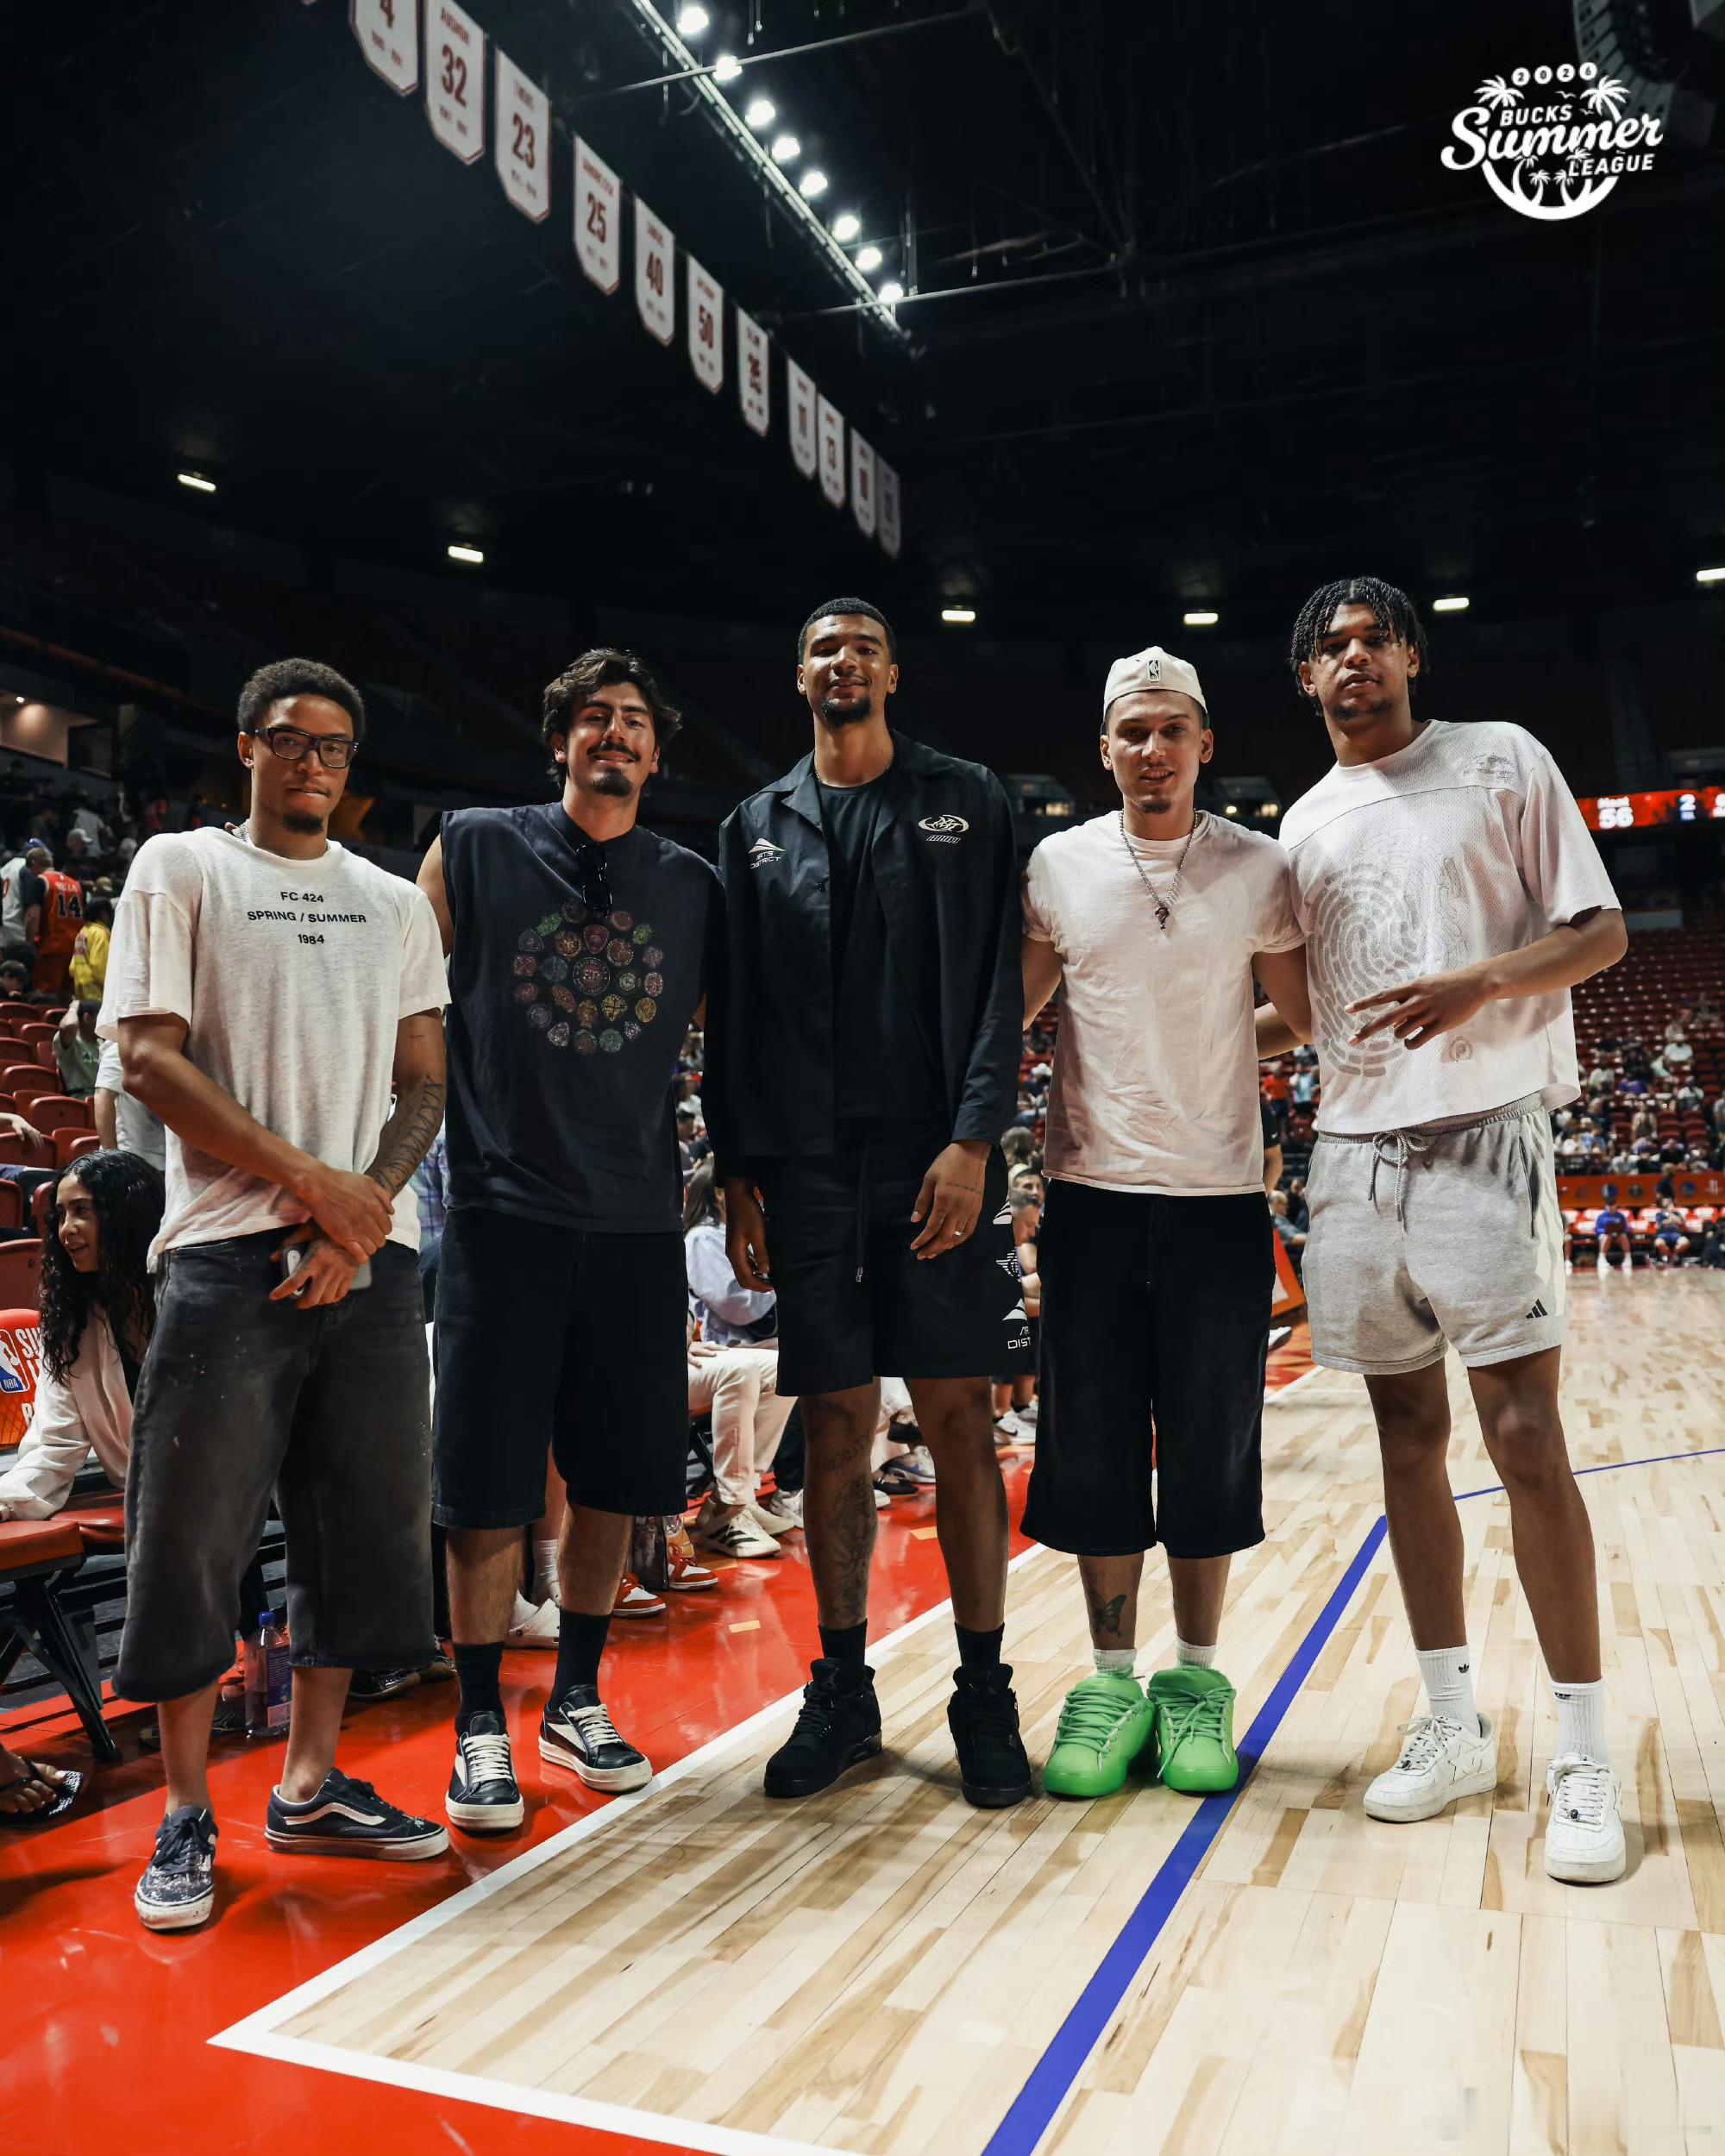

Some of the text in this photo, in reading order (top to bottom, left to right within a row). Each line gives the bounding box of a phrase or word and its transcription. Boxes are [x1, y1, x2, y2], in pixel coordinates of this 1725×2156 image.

[442, 44, 467, 108] 32
[513, 113, 535, 170] 23
[587, 192, 606, 243] 25
[57, 892, 84, 919] 14
[280, 892, 324, 903] FC 424
[248, 911, 367, 923] SPRING / SUMMER
[298, 934, 325, 944] 1984
[3, 1377, 19, 1389] NBA
